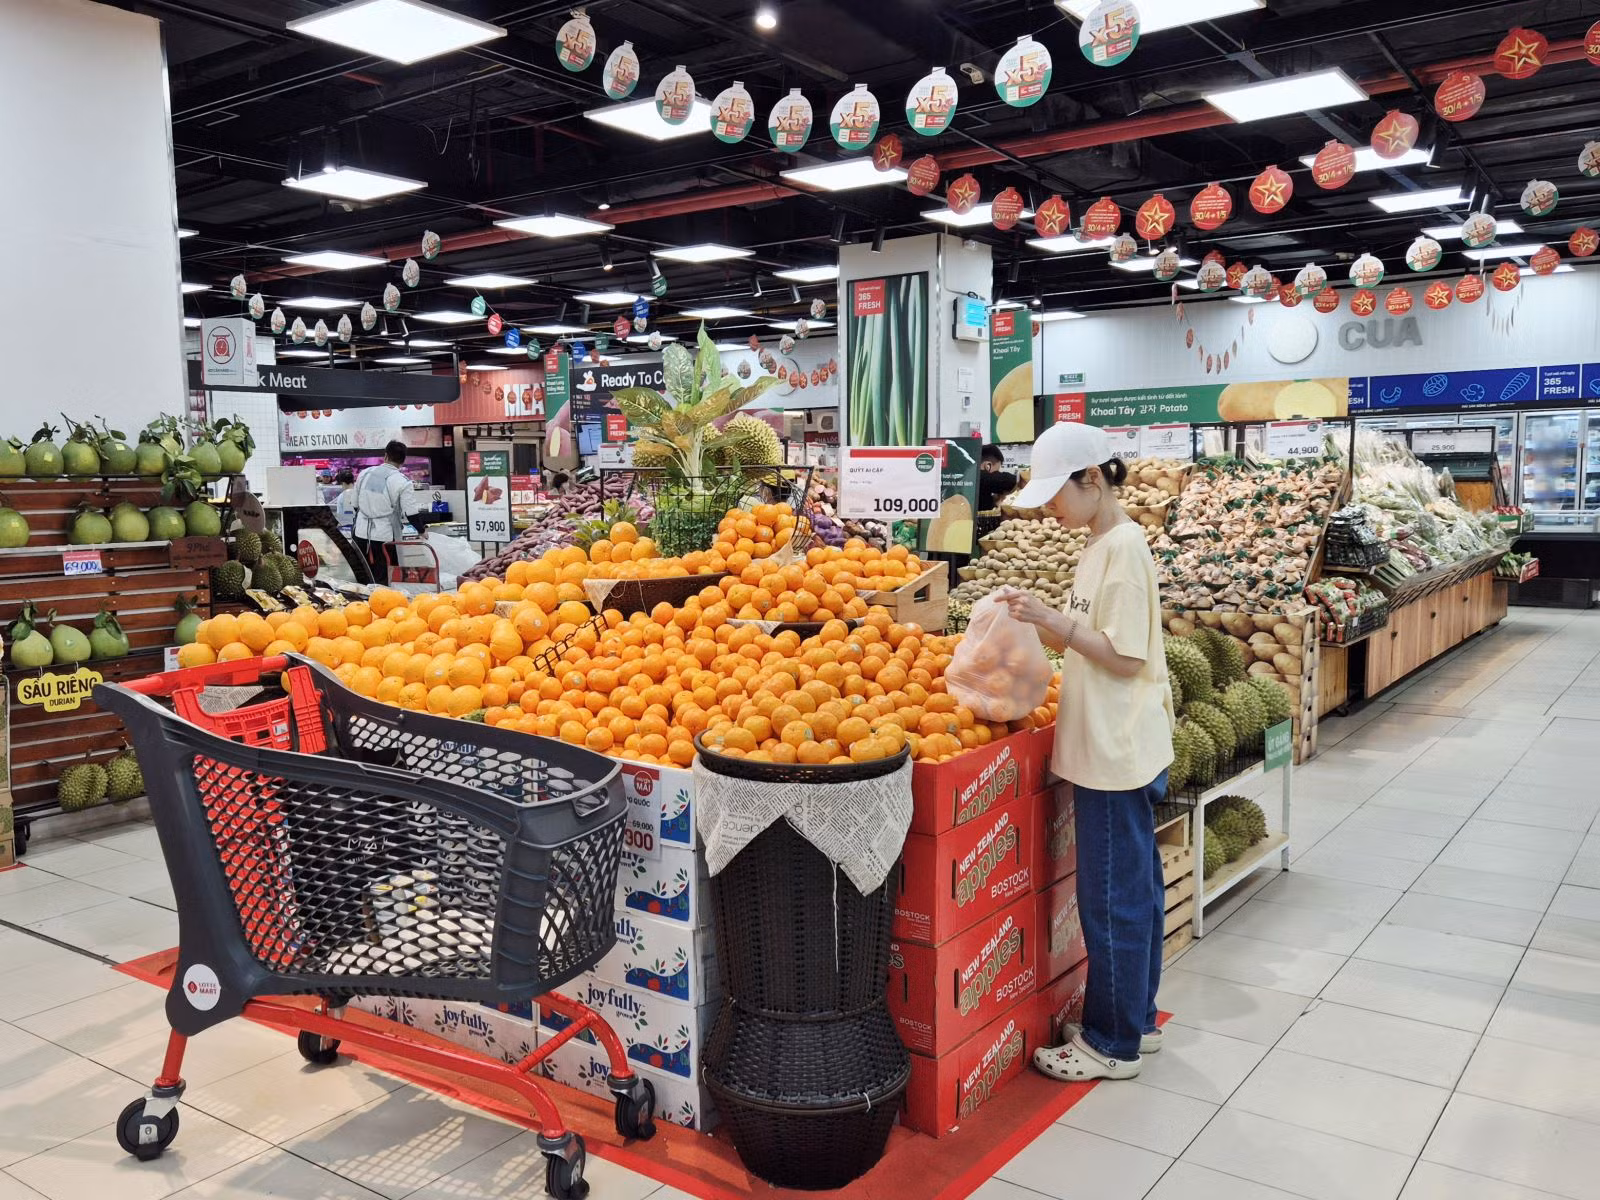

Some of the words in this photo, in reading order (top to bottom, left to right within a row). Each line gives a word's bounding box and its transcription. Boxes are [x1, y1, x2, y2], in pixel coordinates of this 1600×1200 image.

[1588, 44, 1600, 54] 30
[858, 293, 871, 301] 365
[858, 301, 881, 310] FRESH
[1338, 317, 1423, 351] CUA
[269, 372, 307, 388] Meat
[601, 372, 635, 388] Ready
[638, 371, 651, 385] To
[1544, 378, 1562, 386] 365
[504, 383, 544, 416] MEA
[1544, 386, 1575, 395] FRESH
[1058, 412, 1081, 420] FRESH
[1091, 406, 1116, 416] Khoai
[1118, 405, 1135, 416] Tây
[1160, 404, 1188, 413] Potato
[286, 435, 309, 447] MEAT
[311, 434, 348, 446] STATION
[1288, 446, 1319, 456] 44,900
[874, 498, 938, 514] 109,000
[476, 521, 505, 533] 57,900
[23, 677, 51, 699] SẦU
[49, 697, 75, 706] DURIAN
[962, 781, 978, 805] NEW
[979, 746, 1010, 786] ZEALAND
[957, 759, 1017, 825] apples
[1053, 814, 1068, 832] NEW
[959, 848, 977, 875] NEW
[977, 812, 1009, 856] ZEALAND
[957, 824, 1016, 908] apples
[991, 867, 1029, 898] BOSTOCK
[894, 908, 930, 920] BOSTOCK
[961, 958, 980, 984] NEW
[981, 915, 1013, 957] ZEALAND
[959, 926, 1020, 1017] apples
[996, 965, 1034, 1003] BOSTOCK
[585, 982, 642, 1019] joyfully
[442, 1005, 490, 1036] joyfully
[899, 1017, 932, 1031] BOSTOCK
[1055, 1006, 1070, 1027] NEW
[963, 1068, 981, 1093] NEW
[981, 1019, 1015, 1067] ZEALAND
[959, 1030, 1023, 1121] apples
